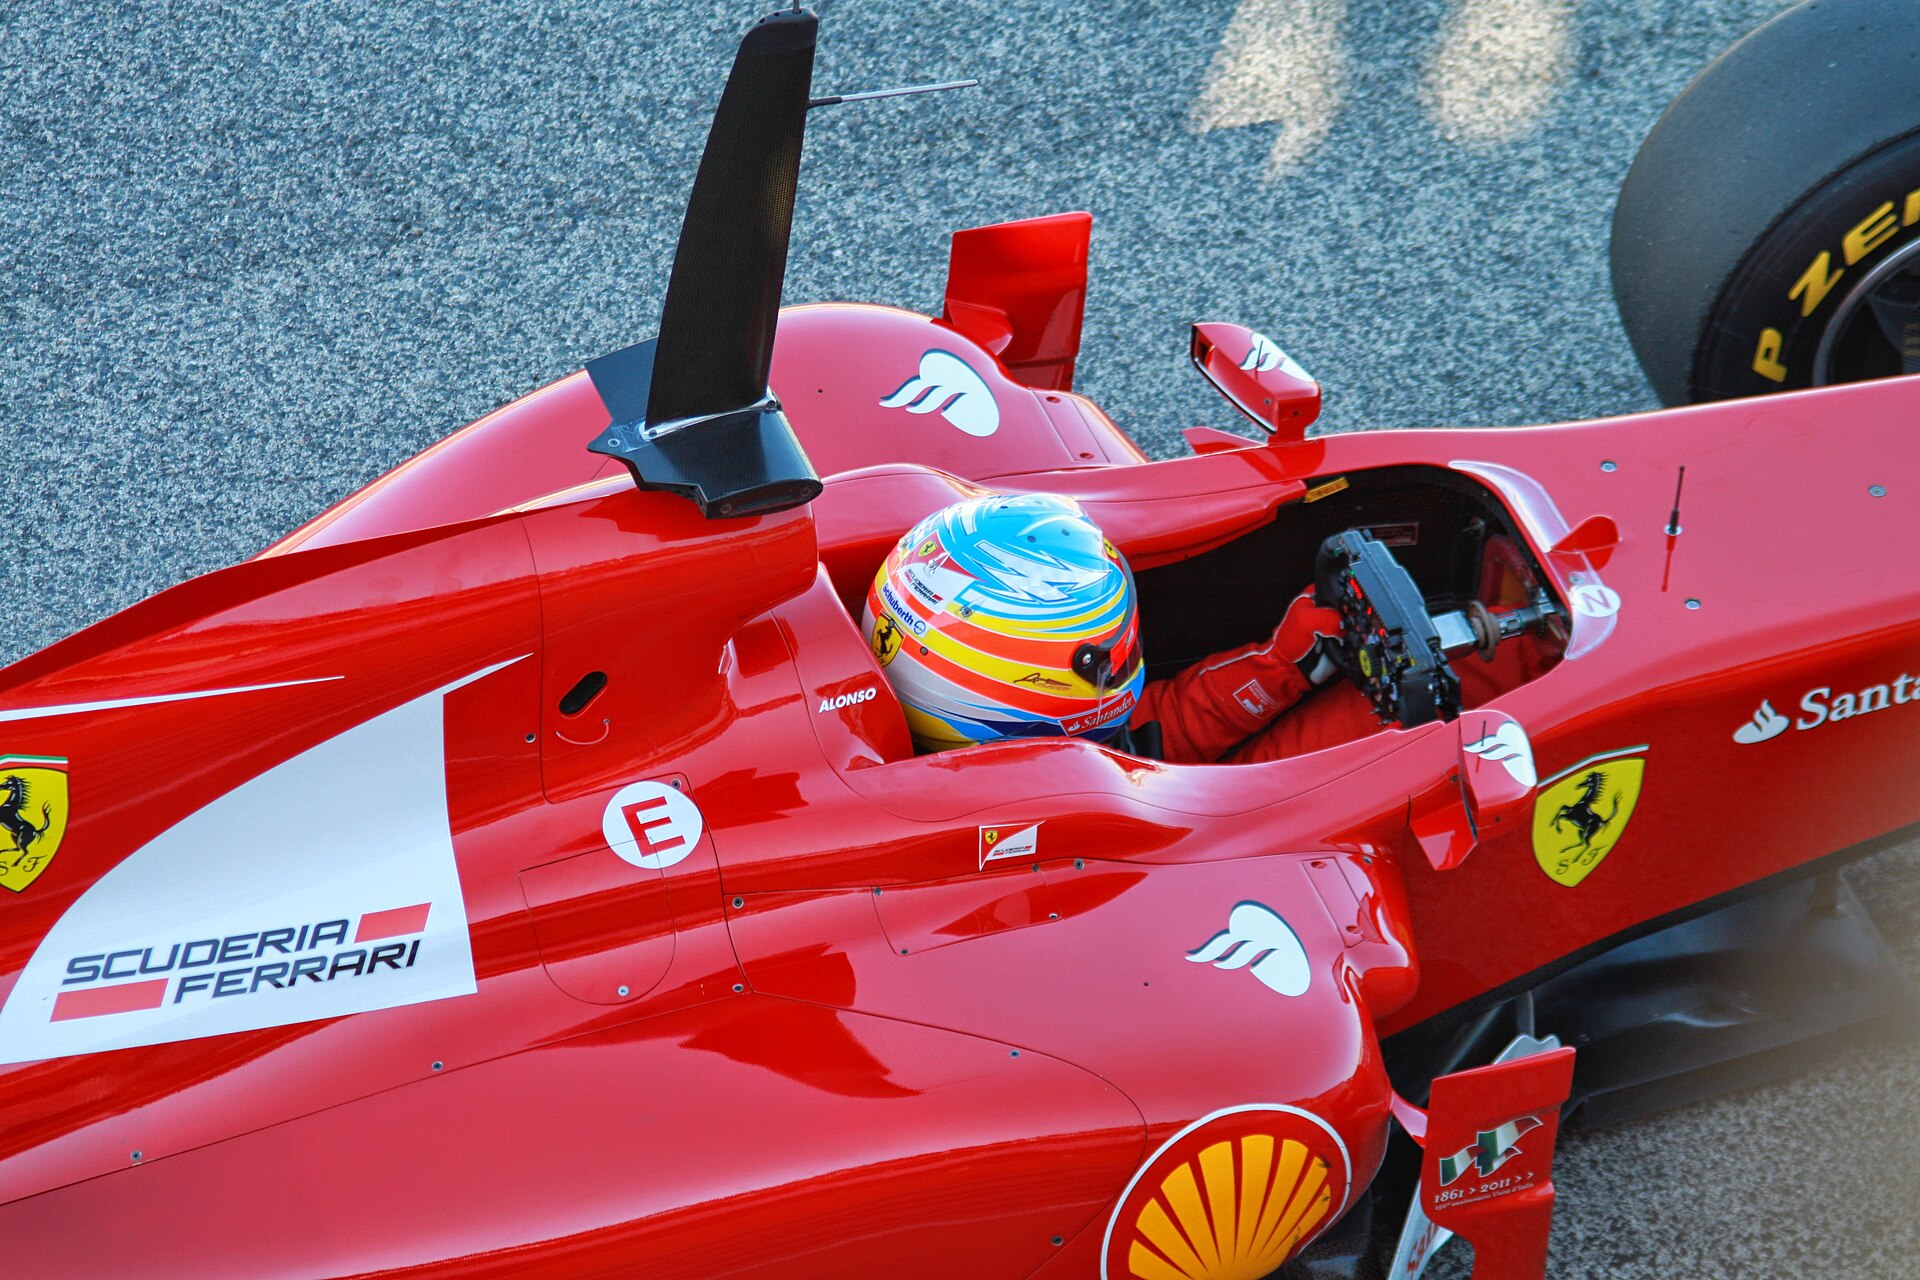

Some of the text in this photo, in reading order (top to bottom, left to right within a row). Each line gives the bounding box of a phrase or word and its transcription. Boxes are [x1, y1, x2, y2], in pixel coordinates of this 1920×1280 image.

[1751, 327, 1788, 383] P
[882, 583, 914, 625] Schuberth
[819, 687, 877, 714] ALONSO
[1081, 695, 1133, 729] Santander
[621, 796, 687, 858] E
[61, 918, 350, 986] SCUDERIA
[173, 940, 421, 1004] FERRARI
[1434, 1190, 1464, 1203] 1861
[1480, 1179, 1511, 1193] 2011
